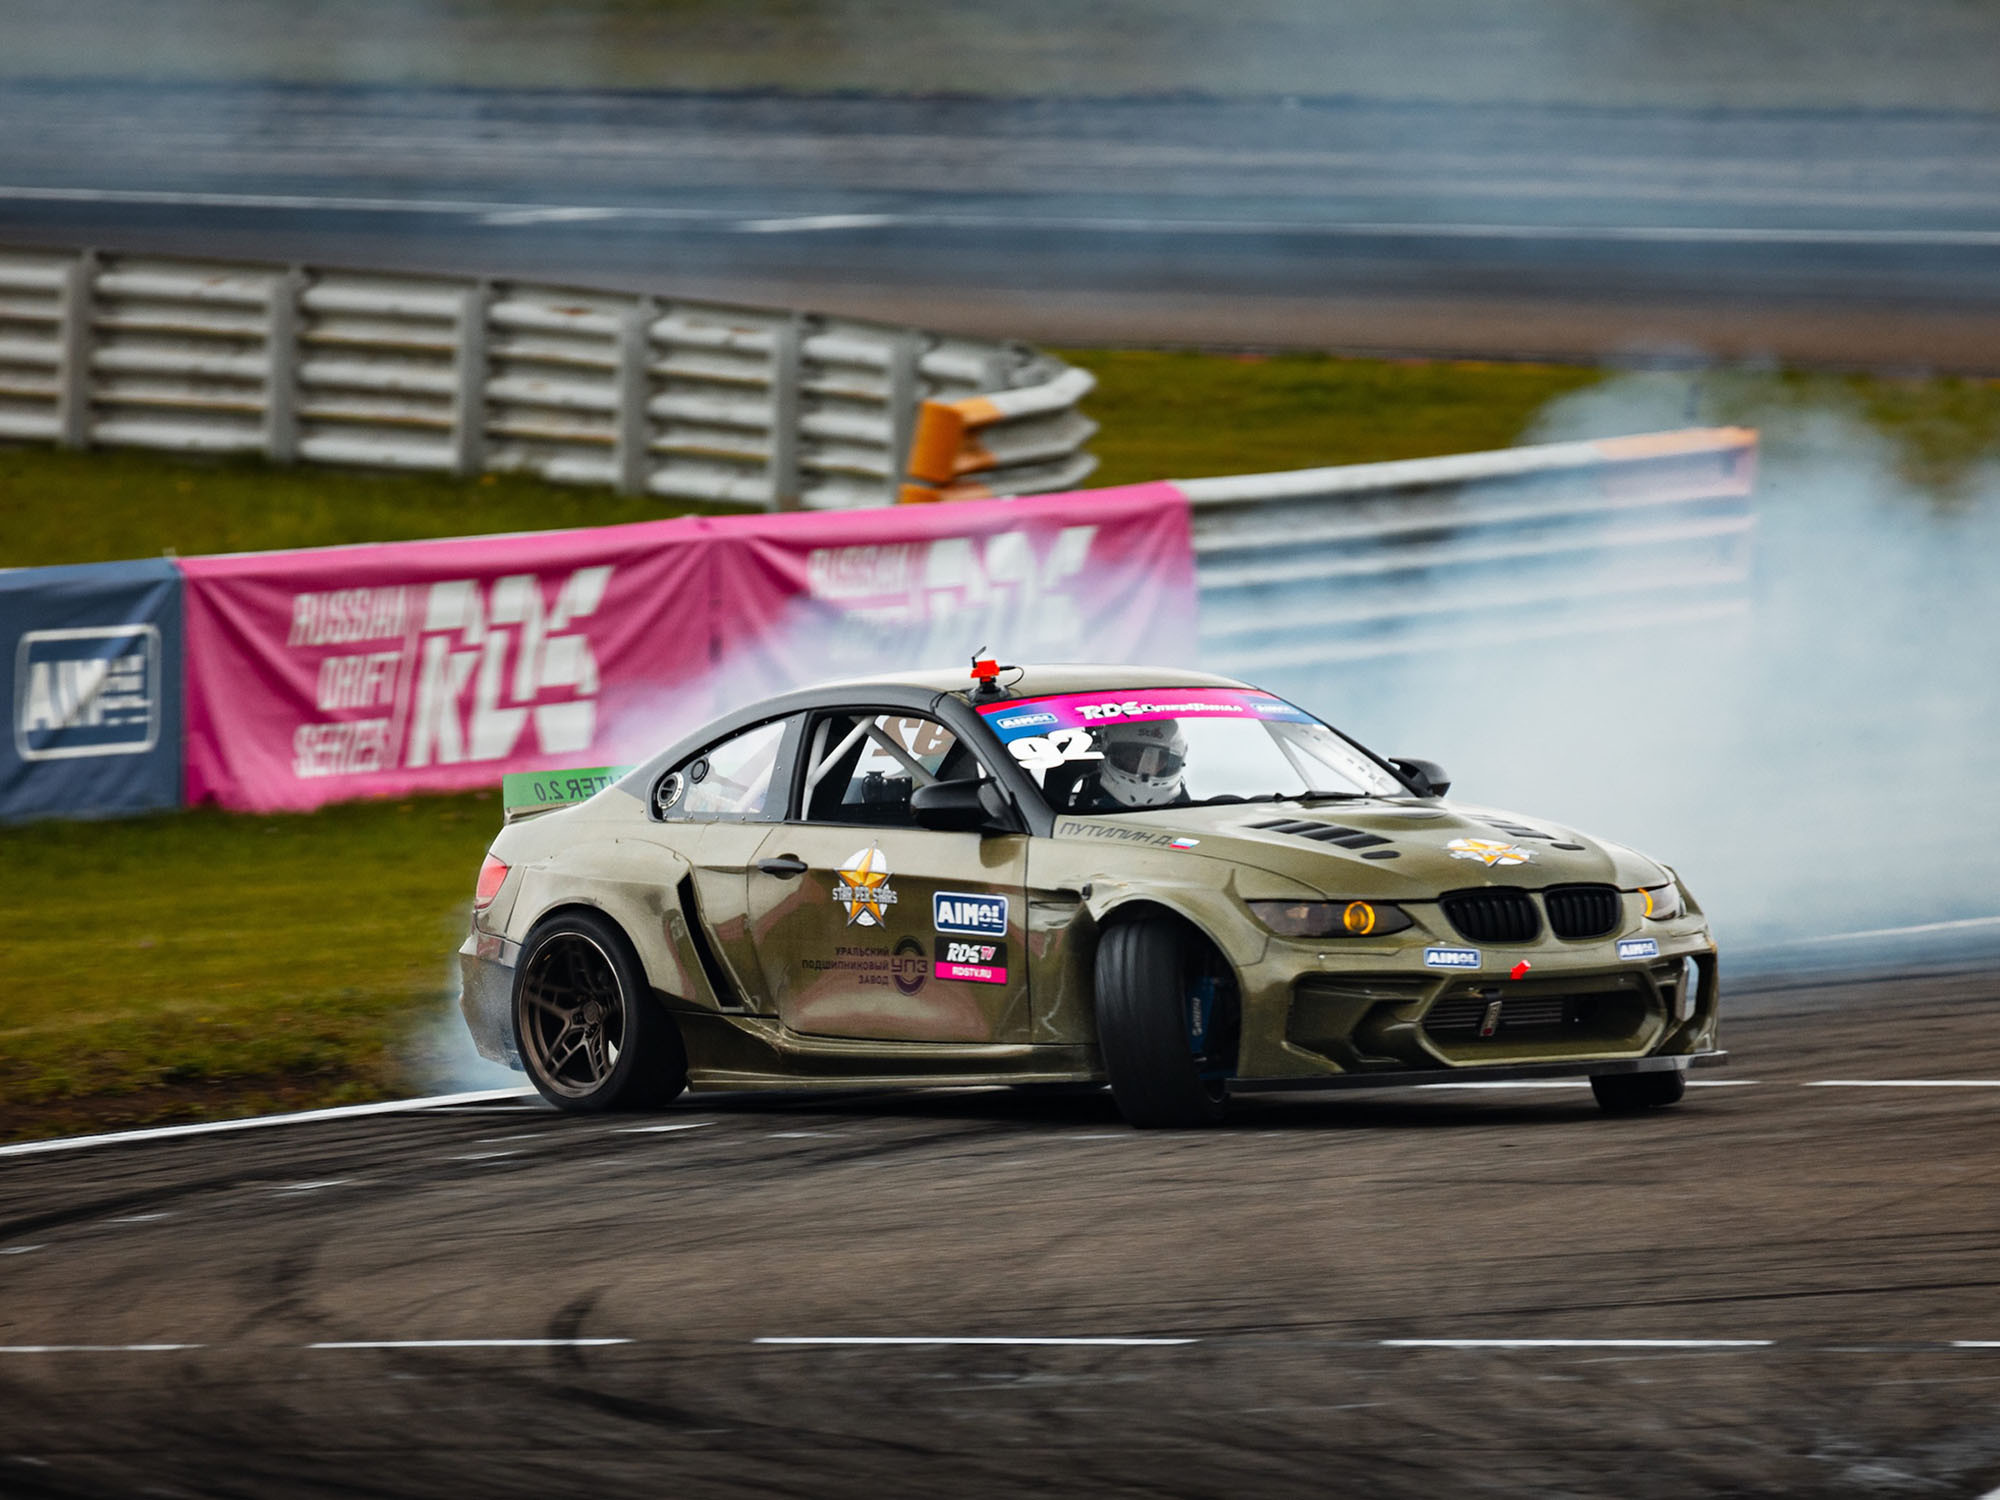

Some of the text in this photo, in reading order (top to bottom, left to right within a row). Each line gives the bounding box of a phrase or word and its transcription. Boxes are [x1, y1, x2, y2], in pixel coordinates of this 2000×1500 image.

[1007, 727, 1104, 769] 92
[937, 901, 1004, 927] AIMOL
[835, 946, 890, 957] УРАЛЬСКИЙ
[946, 942, 981, 964] RDS
[801, 958, 890, 971] ПОДШИПНИКОВЫЙ
[891, 958, 928, 973] УПЗ
[858, 974, 889, 986] ЗАВОД
